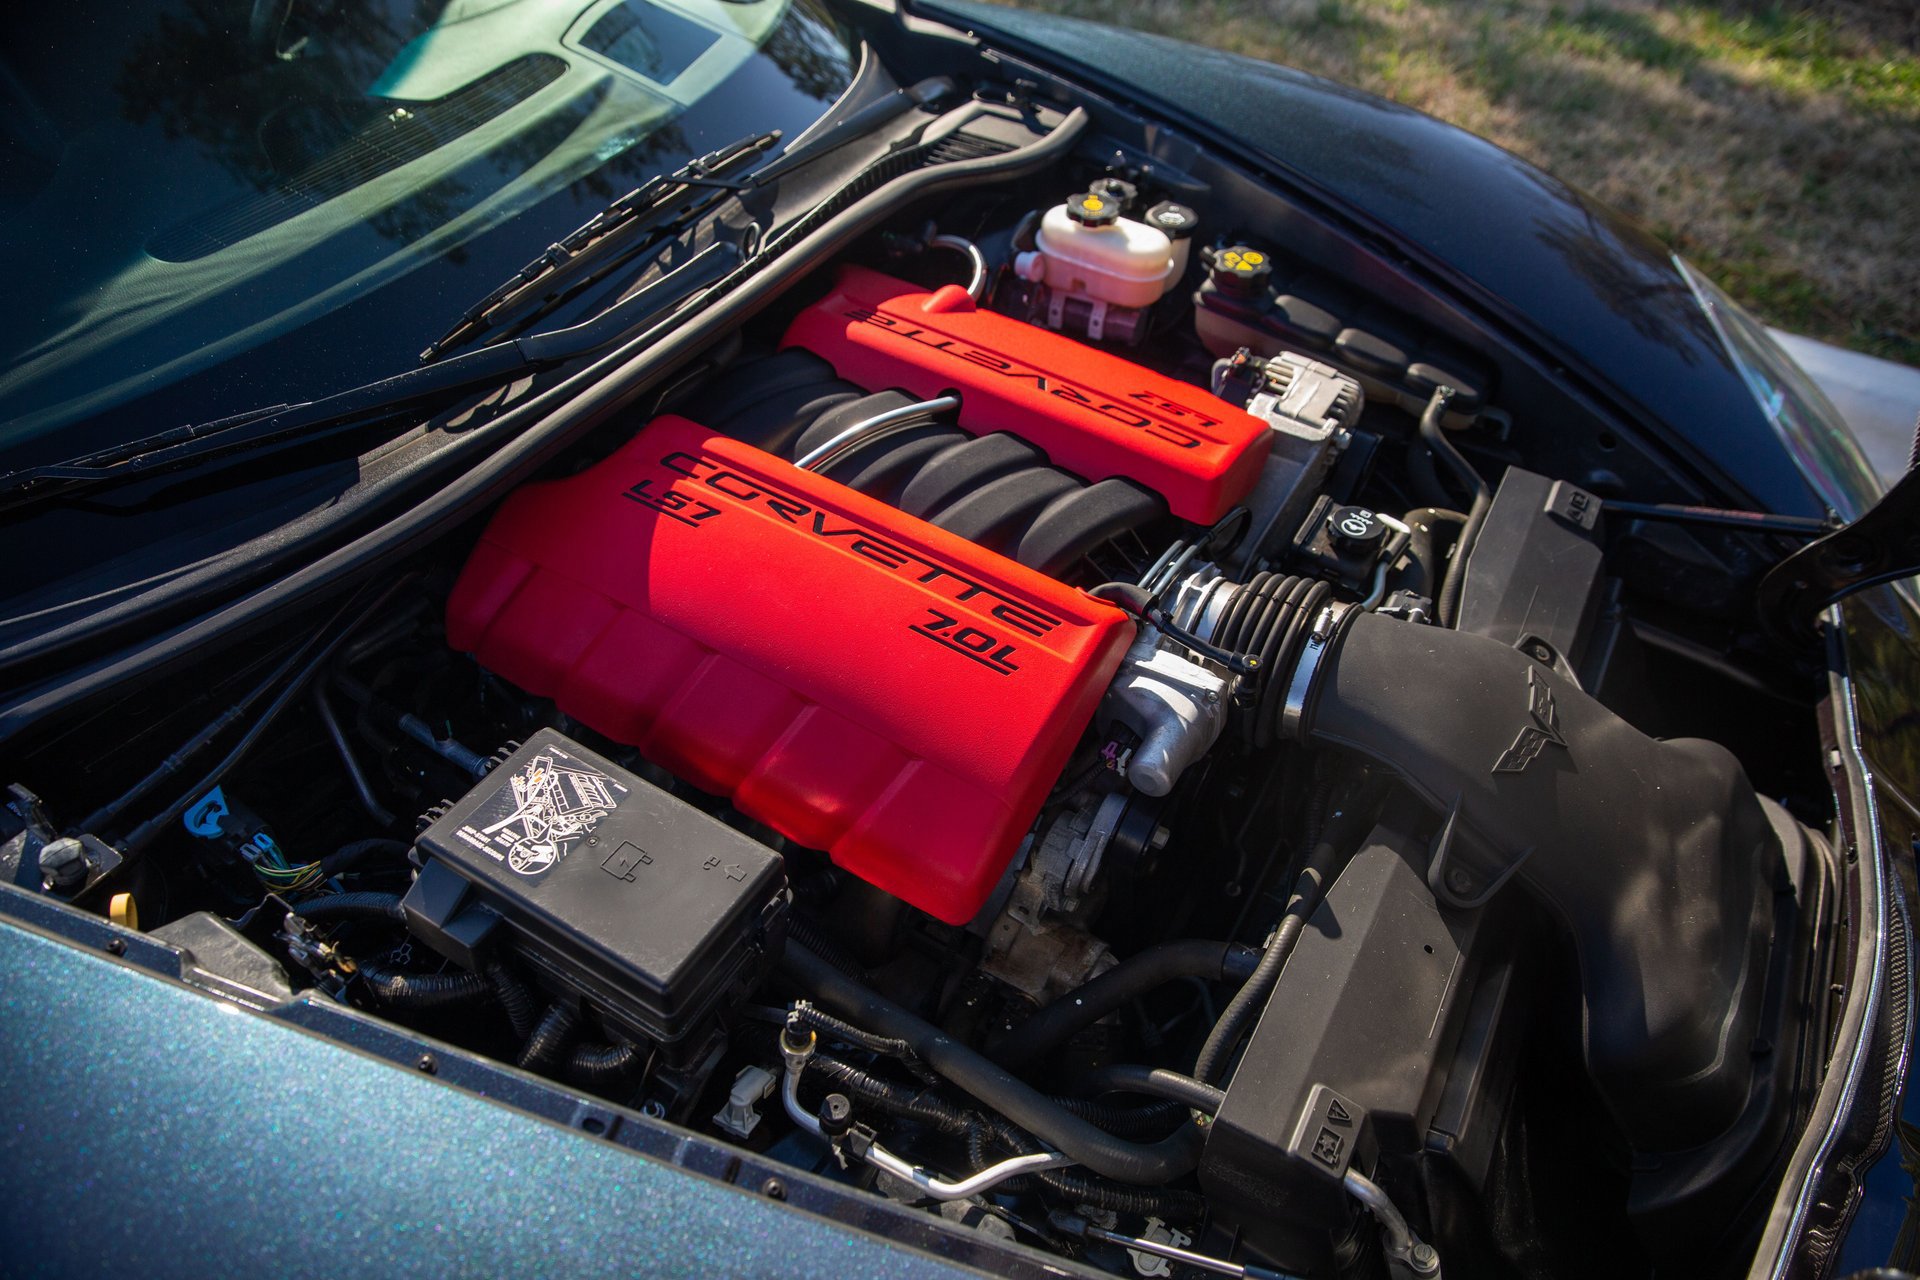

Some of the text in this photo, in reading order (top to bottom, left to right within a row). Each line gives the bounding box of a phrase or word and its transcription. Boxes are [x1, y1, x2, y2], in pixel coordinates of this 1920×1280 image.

[843, 309, 1200, 448] CORVETTE
[1127, 393, 1217, 427] LS7
[630, 480, 721, 520] LS7
[661, 451, 1062, 637] CORVETTE
[923, 608, 1020, 671] 7.0L
